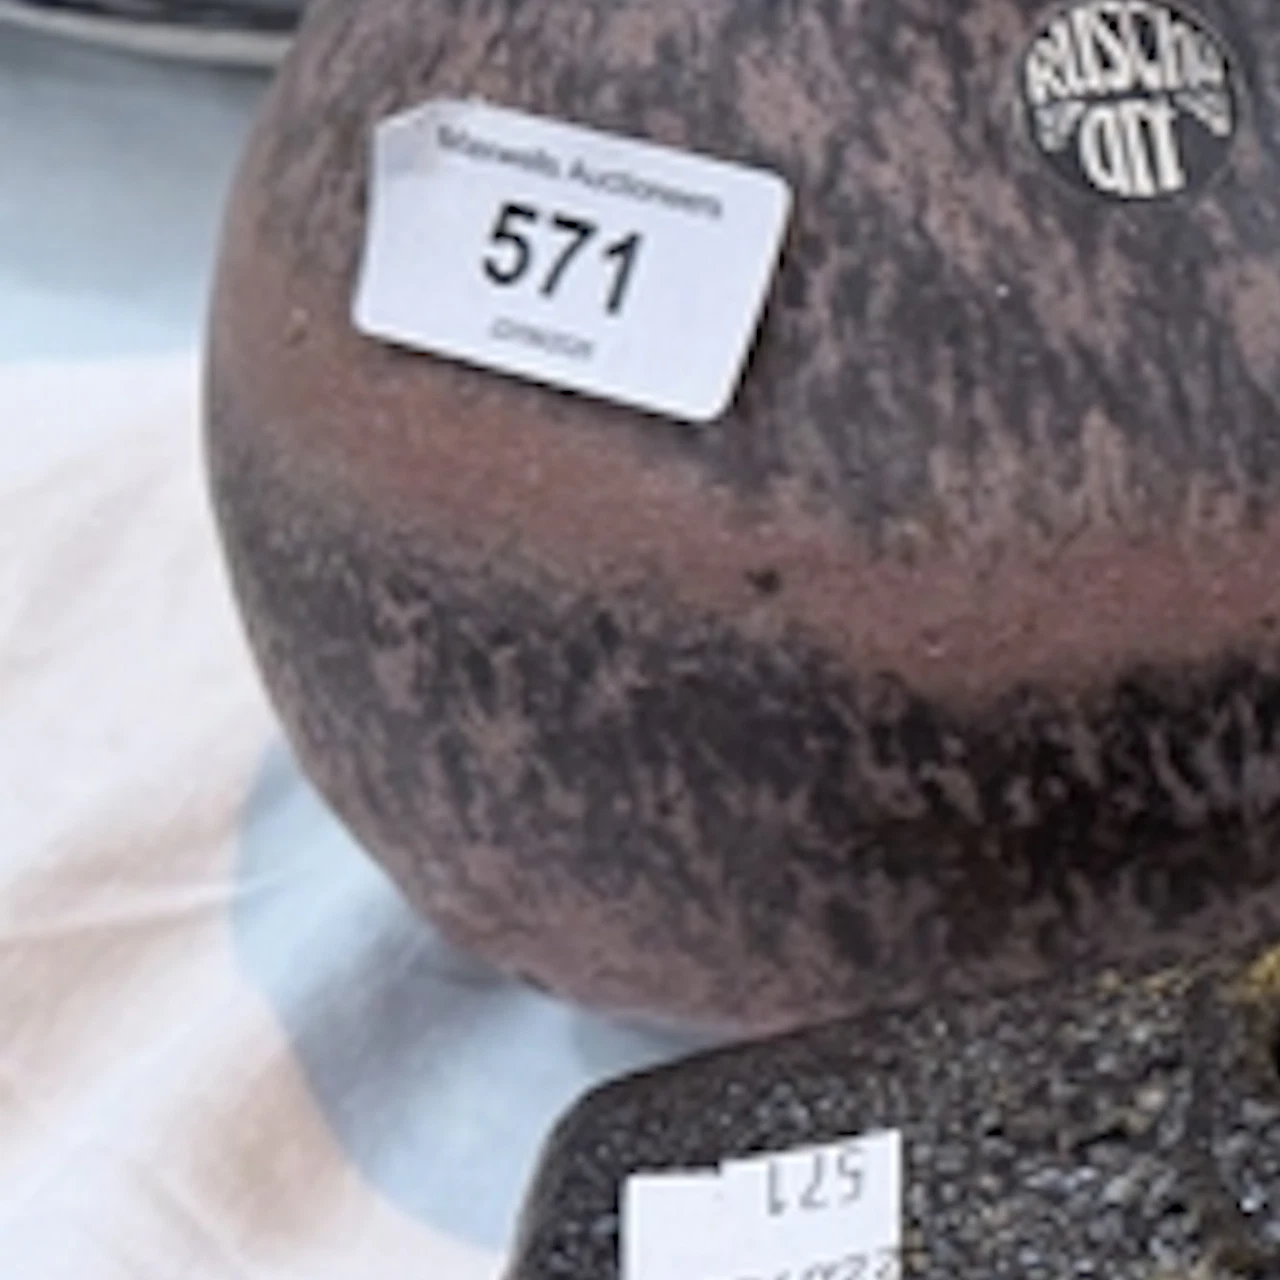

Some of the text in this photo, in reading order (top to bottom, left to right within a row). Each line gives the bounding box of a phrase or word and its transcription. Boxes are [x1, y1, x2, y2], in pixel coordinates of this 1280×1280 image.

[568, 158, 724, 220] Auctioneers
[482, 201, 645, 317] 571
[765, 1147, 864, 1218] 571
